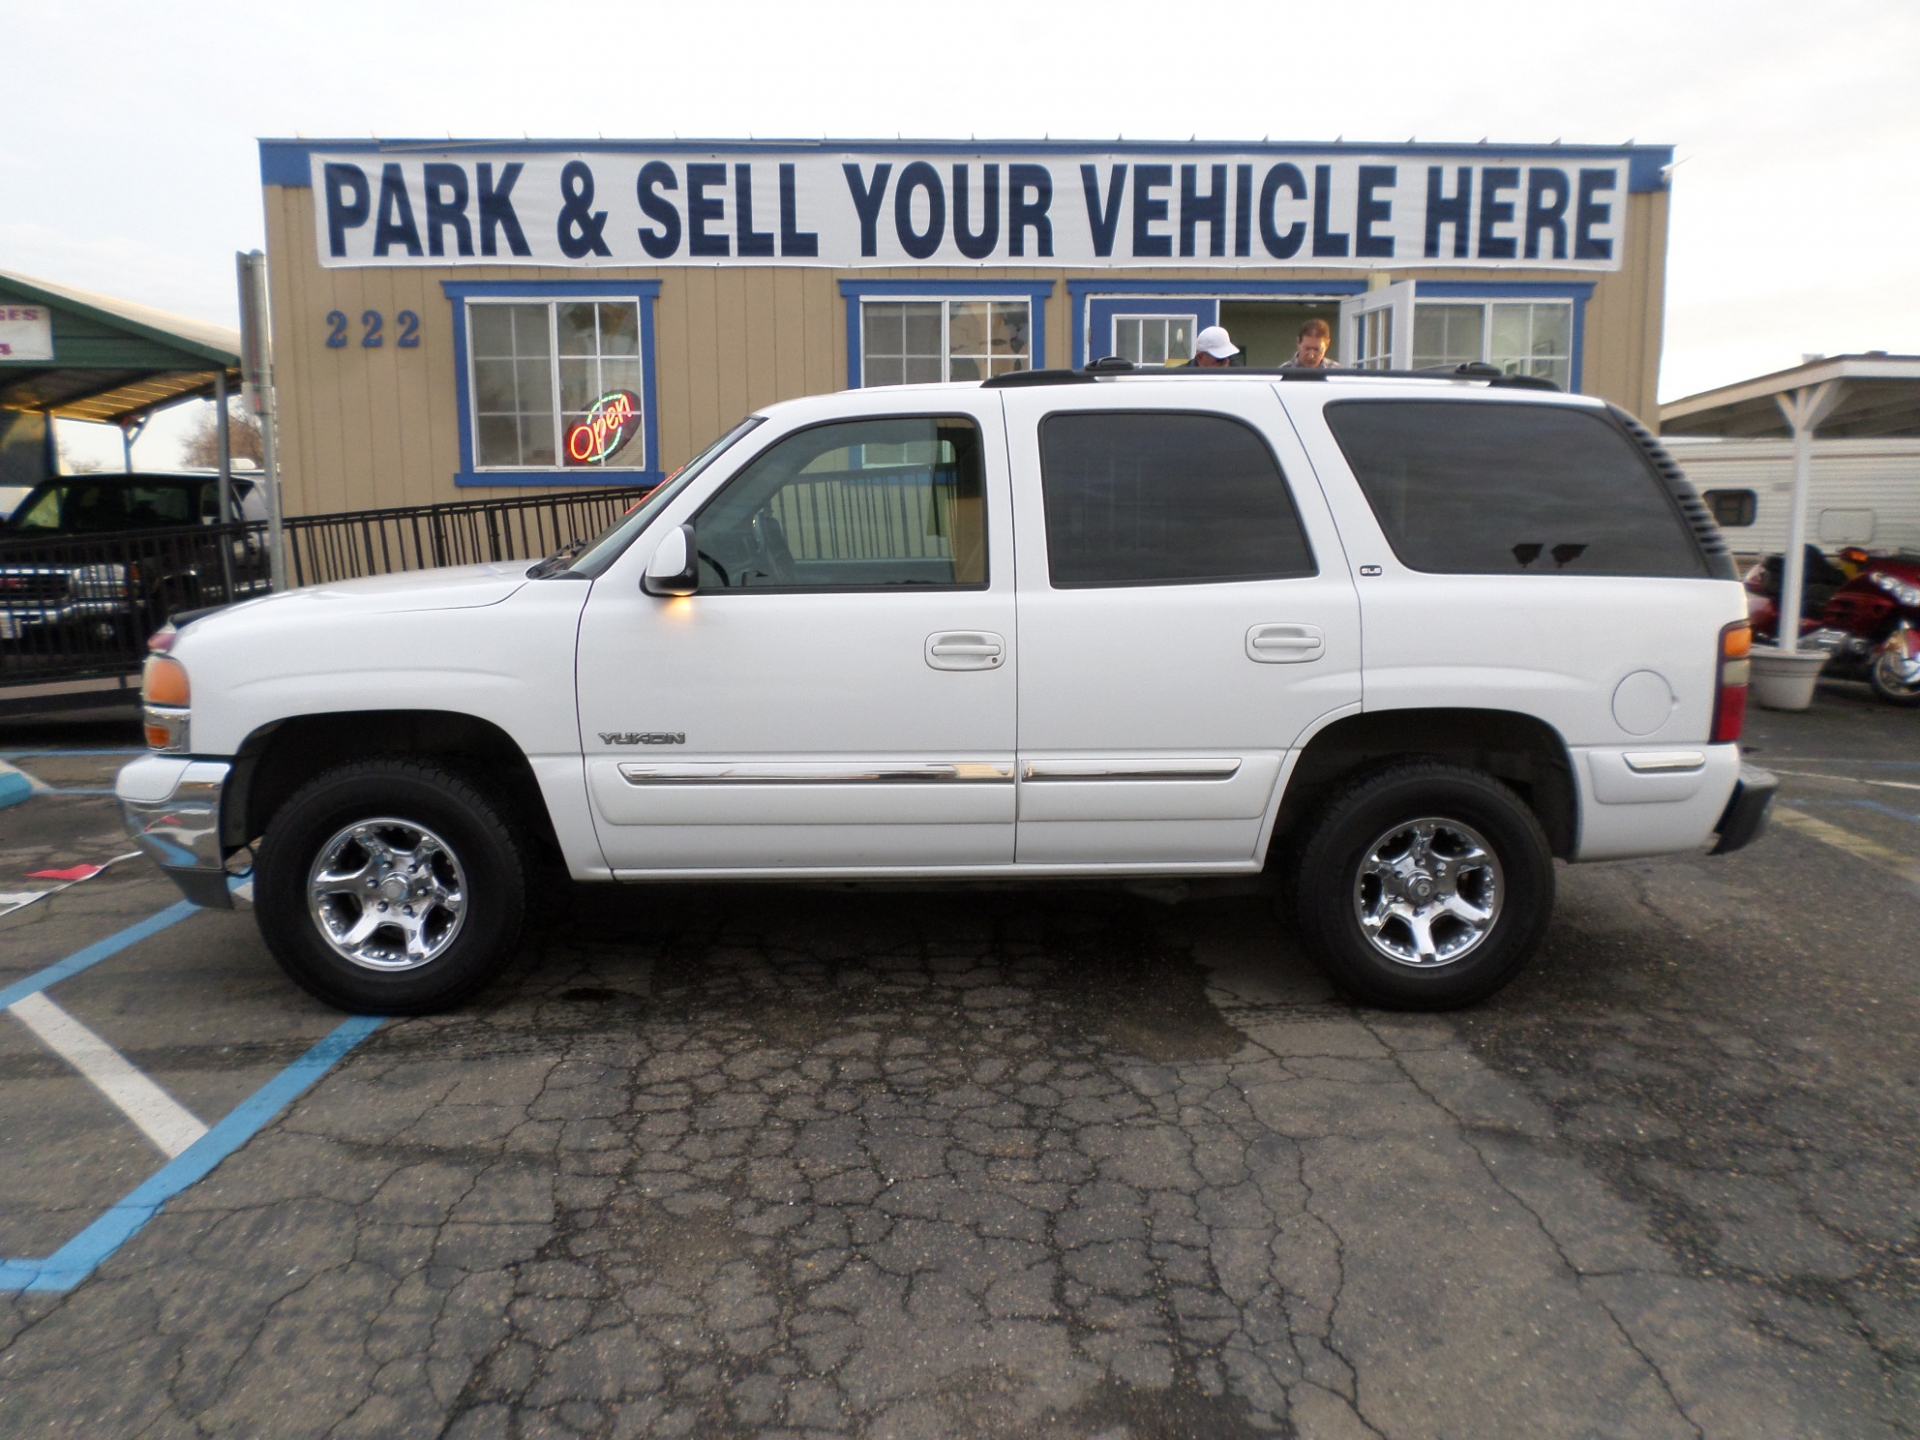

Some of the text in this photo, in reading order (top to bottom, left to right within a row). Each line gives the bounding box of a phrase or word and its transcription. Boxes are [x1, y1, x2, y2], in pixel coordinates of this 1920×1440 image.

[324, 160, 1617, 260] PARK & SELL YOUR VEHICLE HERE
[326, 310, 420, 348] 222
[570, 393, 632, 459] Open
[598, 732, 685, 745] YUKON
